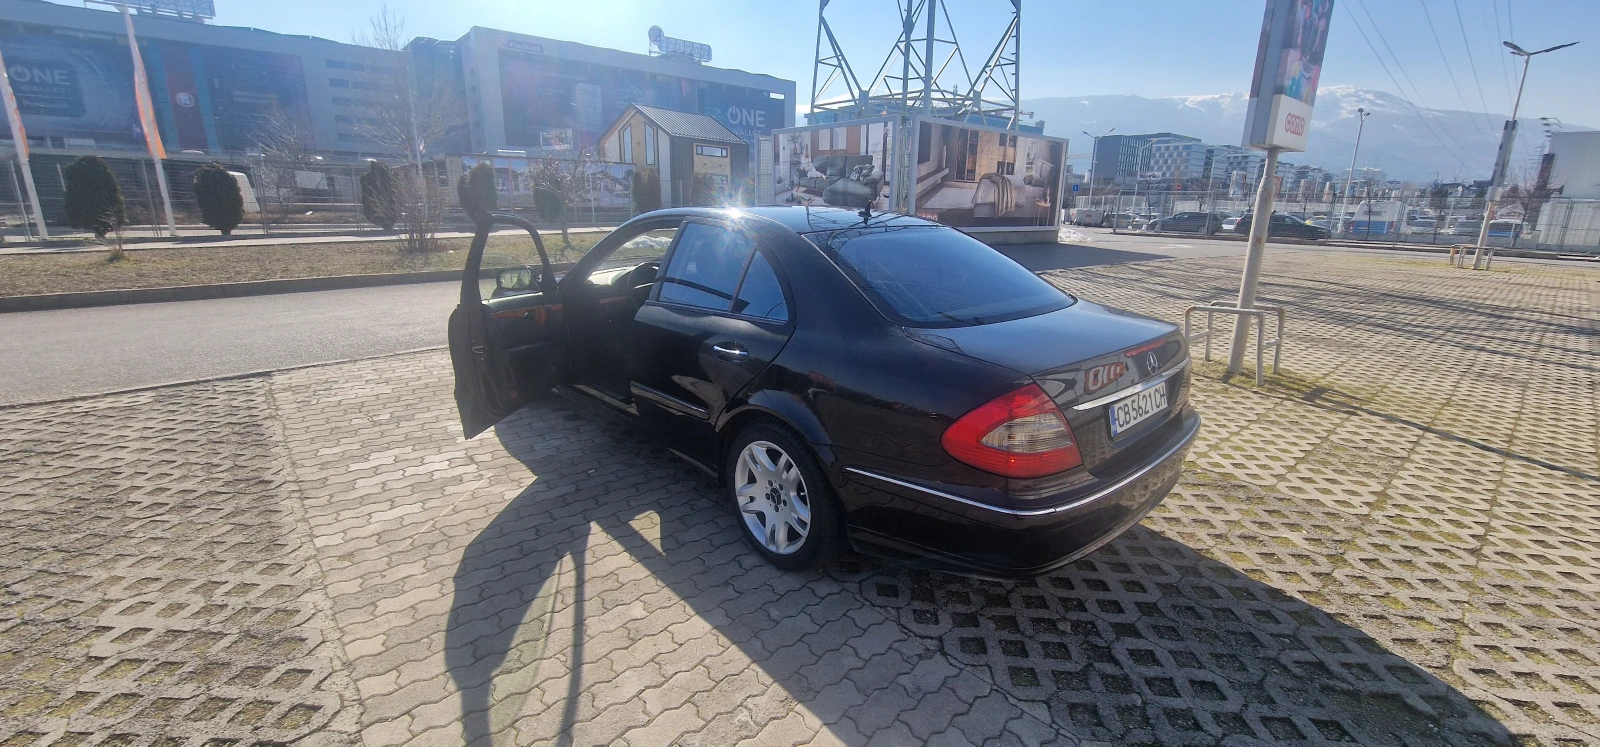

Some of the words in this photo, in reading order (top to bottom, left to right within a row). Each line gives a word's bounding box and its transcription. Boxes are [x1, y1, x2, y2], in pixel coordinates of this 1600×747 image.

[9, 65, 71, 85] ONE
[20, 84, 66, 94] WALLET
[727, 105, 766, 128] ONE
[1285, 112, 1305, 136] como
[1117, 403, 1131, 428] CB
[1131, 391, 1154, 421] 5621
[1154, 386, 1167, 409] CH
